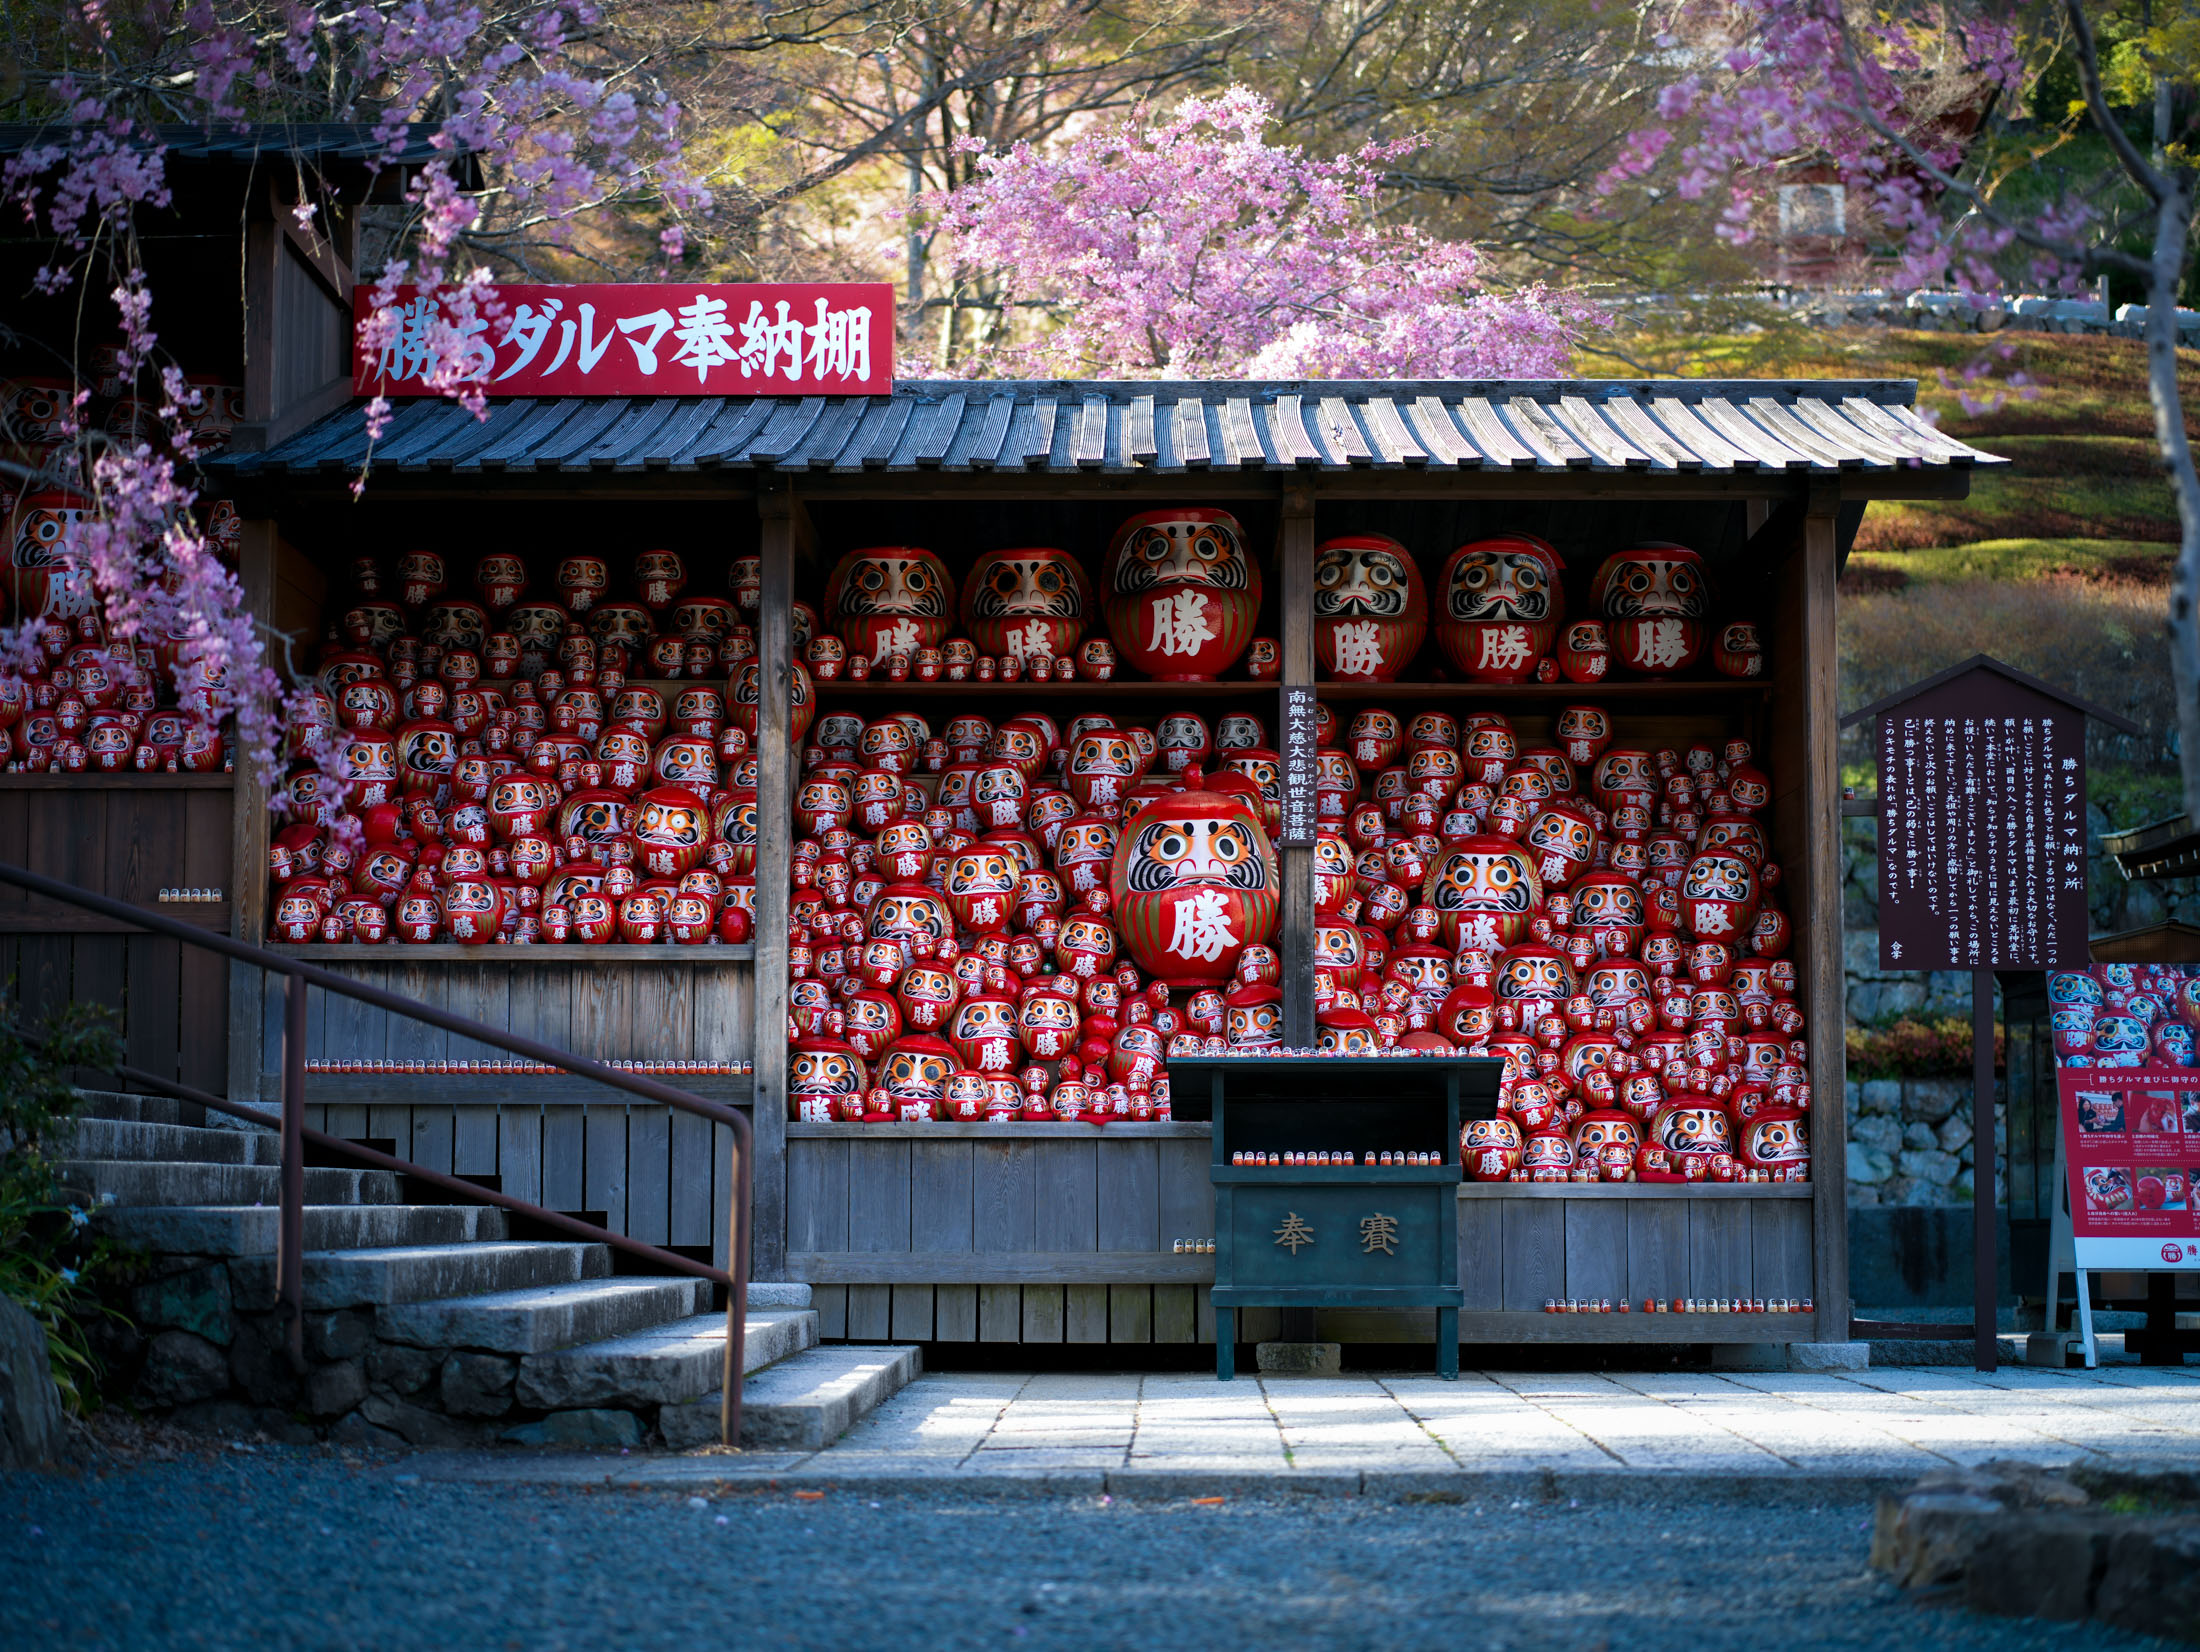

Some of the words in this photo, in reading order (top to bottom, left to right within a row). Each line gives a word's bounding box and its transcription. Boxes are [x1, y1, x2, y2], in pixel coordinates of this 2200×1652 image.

[405, 585, 427, 604] 勝
[492, 587, 515, 606] 勝
[572, 589, 593, 611] 勝
[647, 581, 671, 603] 勝
[1147, 589, 1215, 656] 勝
[1334, 620, 1384, 675] 勝
[1478, 625, 1532, 670] 勝
[1634, 618, 1689, 668] 勝
[819, 663, 835, 678] 勝
[1586, 656, 1606, 675] 勝
[1743, 656, 1761, 676] 勝
[356, 711, 373, 726] 勝
[454, 718, 468, 732] 勝
[1356, 740, 1379, 761] 勝
[1570, 740, 1592, 762] 勝
[612, 762, 636, 787] 勝
[1287, 690, 1307, 841] 南無大慈大悲観世音菩薩
[1481, 761, 1504, 783] 勝
[359, 783, 386, 808] 勝
[1090, 775, 1120, 804] 勝
[866, 802, 889, 824] 勝
[992, 801, 1020, 824] 勝
[1319, 793, 1345, 815] 勝
[510, 814, 535, 835] 勝
[1418, 811, 1433, 825] 勝
[1498, 819, 1514, 833] 勝
[467, 824, 485, 842] 勝
[517, 864, 531, 879] 勝
[648, 850, 676, 874] 勝
[897, 853, 921, 876] 勝
[1539, 855, 1566, 884] 勝
[1072, 863, 1101, 890] 勝
[972, 896, 1000, 924] 勝
[1370, 906, 1385, 920] 勝
[1695, 903, 1734, 935] 勝
[289, 923, 306, 938] 勝
[413, 924, 431, 940] 勝
[454, 915, 477, 938] 勝
[640, 924, 654, 938] 勝
[1165, 889, 1239, 962] 勝
[1891, 941, 1903, 959] 合掌
[877, 970, 892, 984] 勝
[1071, 954, 1096, 978] 勝
[1244, 966, 1260, 982] 勝
[1699, 966, 1713, 981] 勝
[912, 1003, 937, 1025] 勝
[1410, 1014, 1424, 1028] 勝
[850, 1035, 872, 1055] 勝
[979, 1038, 1011, 1070] 勝
[1034, 1030, 1061, 1056] 勝
[1699, 1051, 1714, 1066] 勝
[1781, 1086, 1795, 1103] 勝
[1113, 1100, 1129, 1114] 勝
[1525, 1109, 1543, 1125] 勝
[1479, 1148, 1506, 1175] 勝
